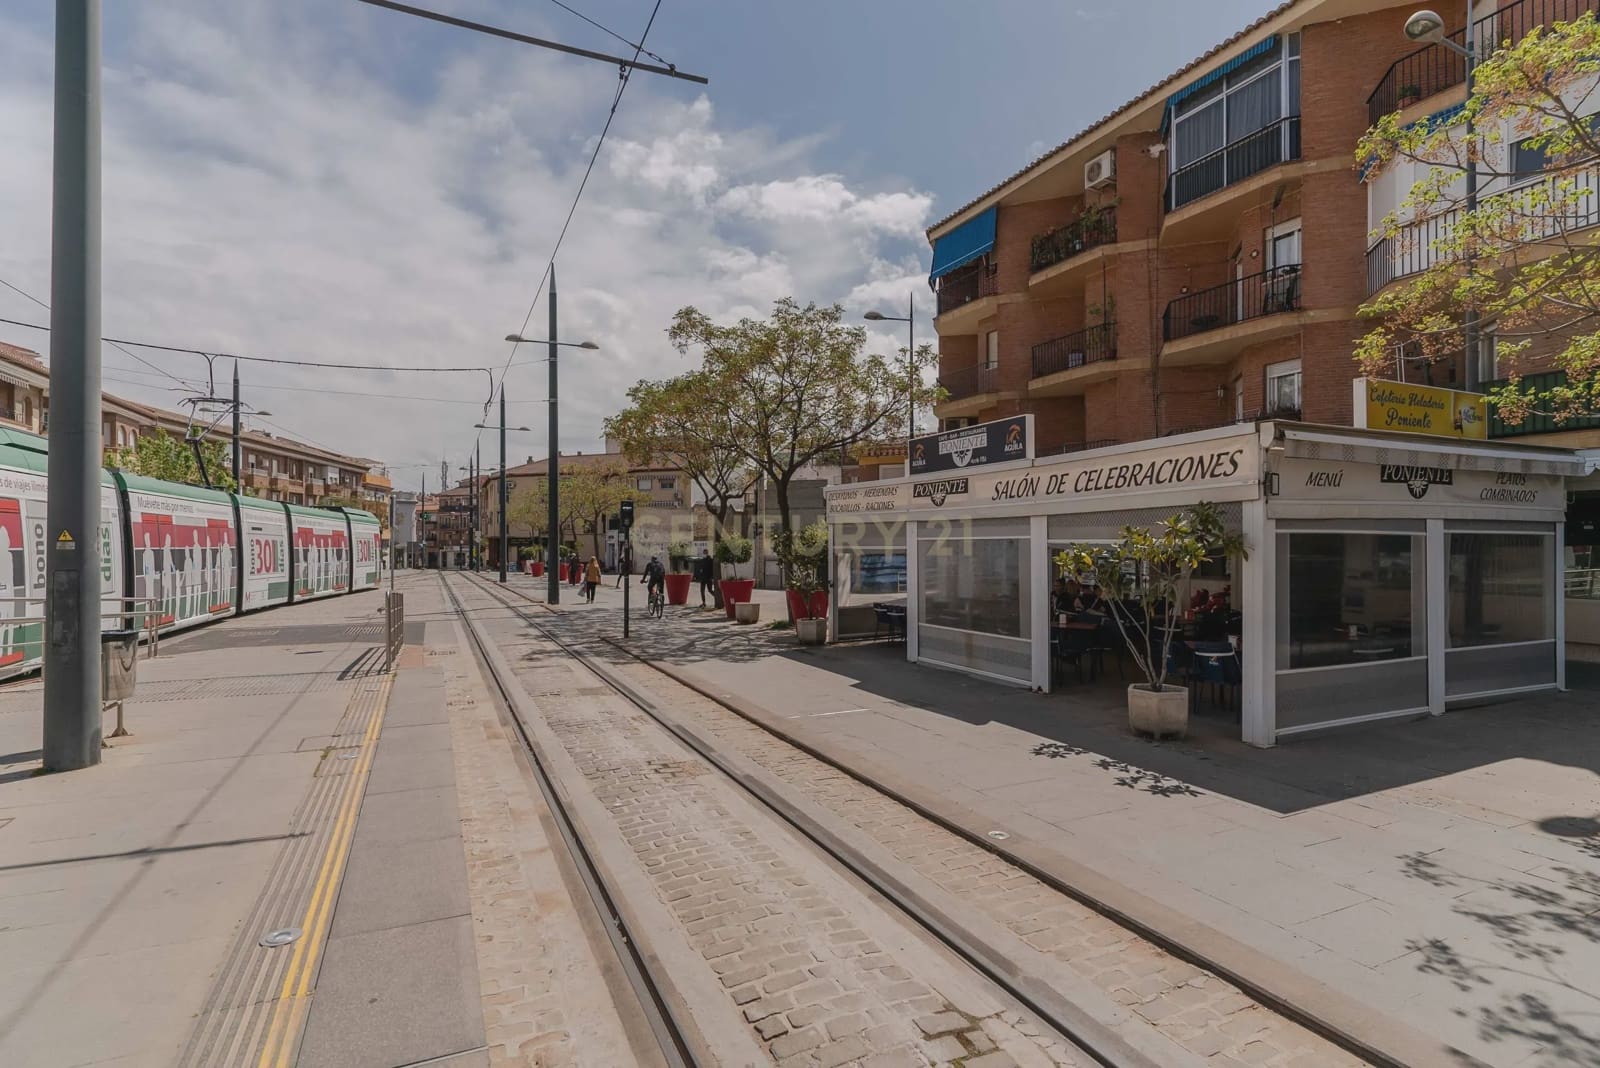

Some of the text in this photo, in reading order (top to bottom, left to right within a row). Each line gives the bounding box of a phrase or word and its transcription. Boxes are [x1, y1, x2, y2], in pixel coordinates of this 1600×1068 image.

[1385, 408, 1432, 428] Poniente
[941, 434, 986, 453] PONIENTE
[992, 449, 1243, 501] SALÓN DE CELEBRACIONES
[1305, 470, 1344, 488] MENÚ
[1383, 464, 1450, 482] PONIENTE
[1495, 473, 1527, 486] PLATOS
[914, 480, 966, 497] PONIENTE
[1479, 487, 1538, 503] COMBINADOS
[865, 501, 895, 511] RACIONES
[34, 523, 46, 589] bono
